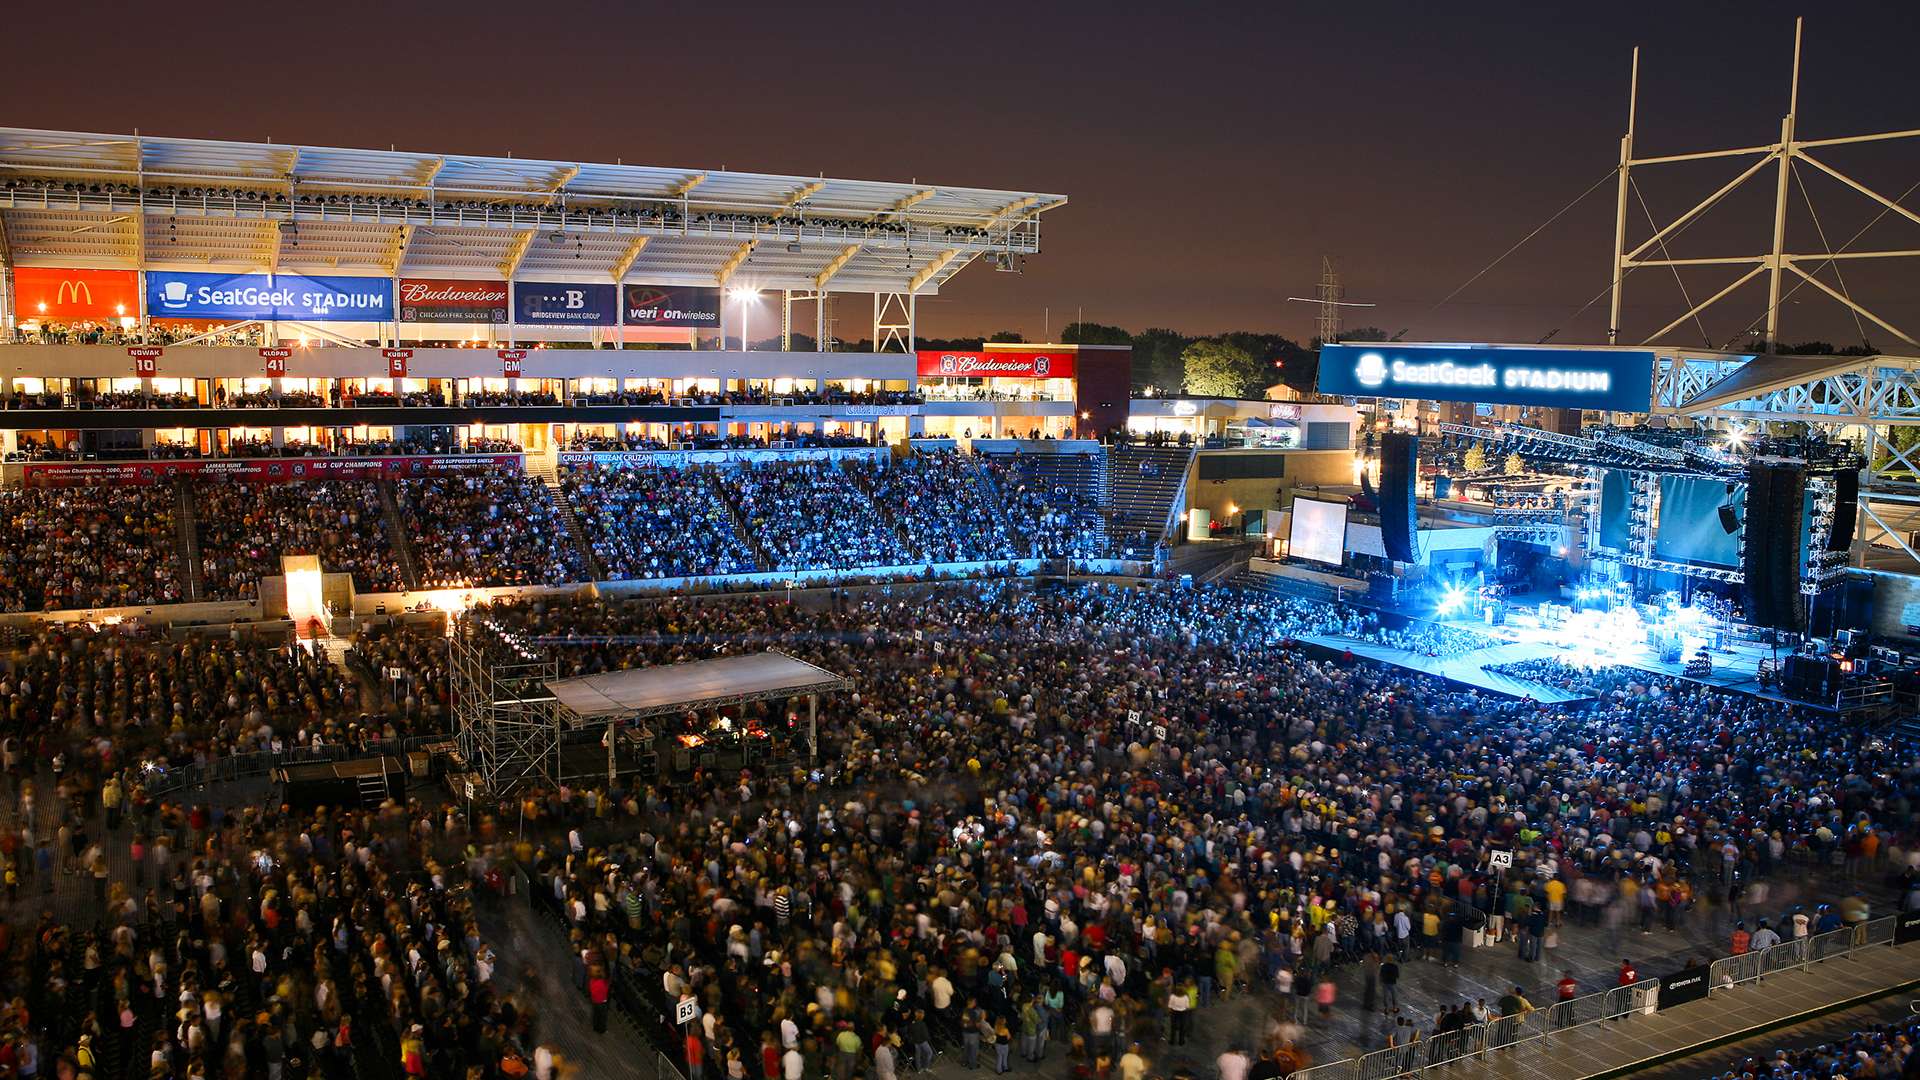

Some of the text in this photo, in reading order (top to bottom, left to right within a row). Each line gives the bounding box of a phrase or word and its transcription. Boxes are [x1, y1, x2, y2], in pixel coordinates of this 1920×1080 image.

[198, 286, 383, 309] SeatGeek STADIUM
[400, 283, 506, 302] Budweiser
[419, 311, 448, 319] CHICAGO
[582, 312, 601, 320] GROUP
[137, 359, 154, 371] 10
[267, 359, 284, 371] 41
[393, 359, 402, 371] 5
[505, 361, 520, 371] GM
[958, 356, 1032, 372] Budweiser
[1393, 360, 1609, 392] SeatGeek STADIUM
[562, 454, 592, 462] CRUZAN
[593, 453, 622, 461] CRUZAN
[1493, 854, 1509, 864] A3
[680, 1003, 693, 1018] B3
